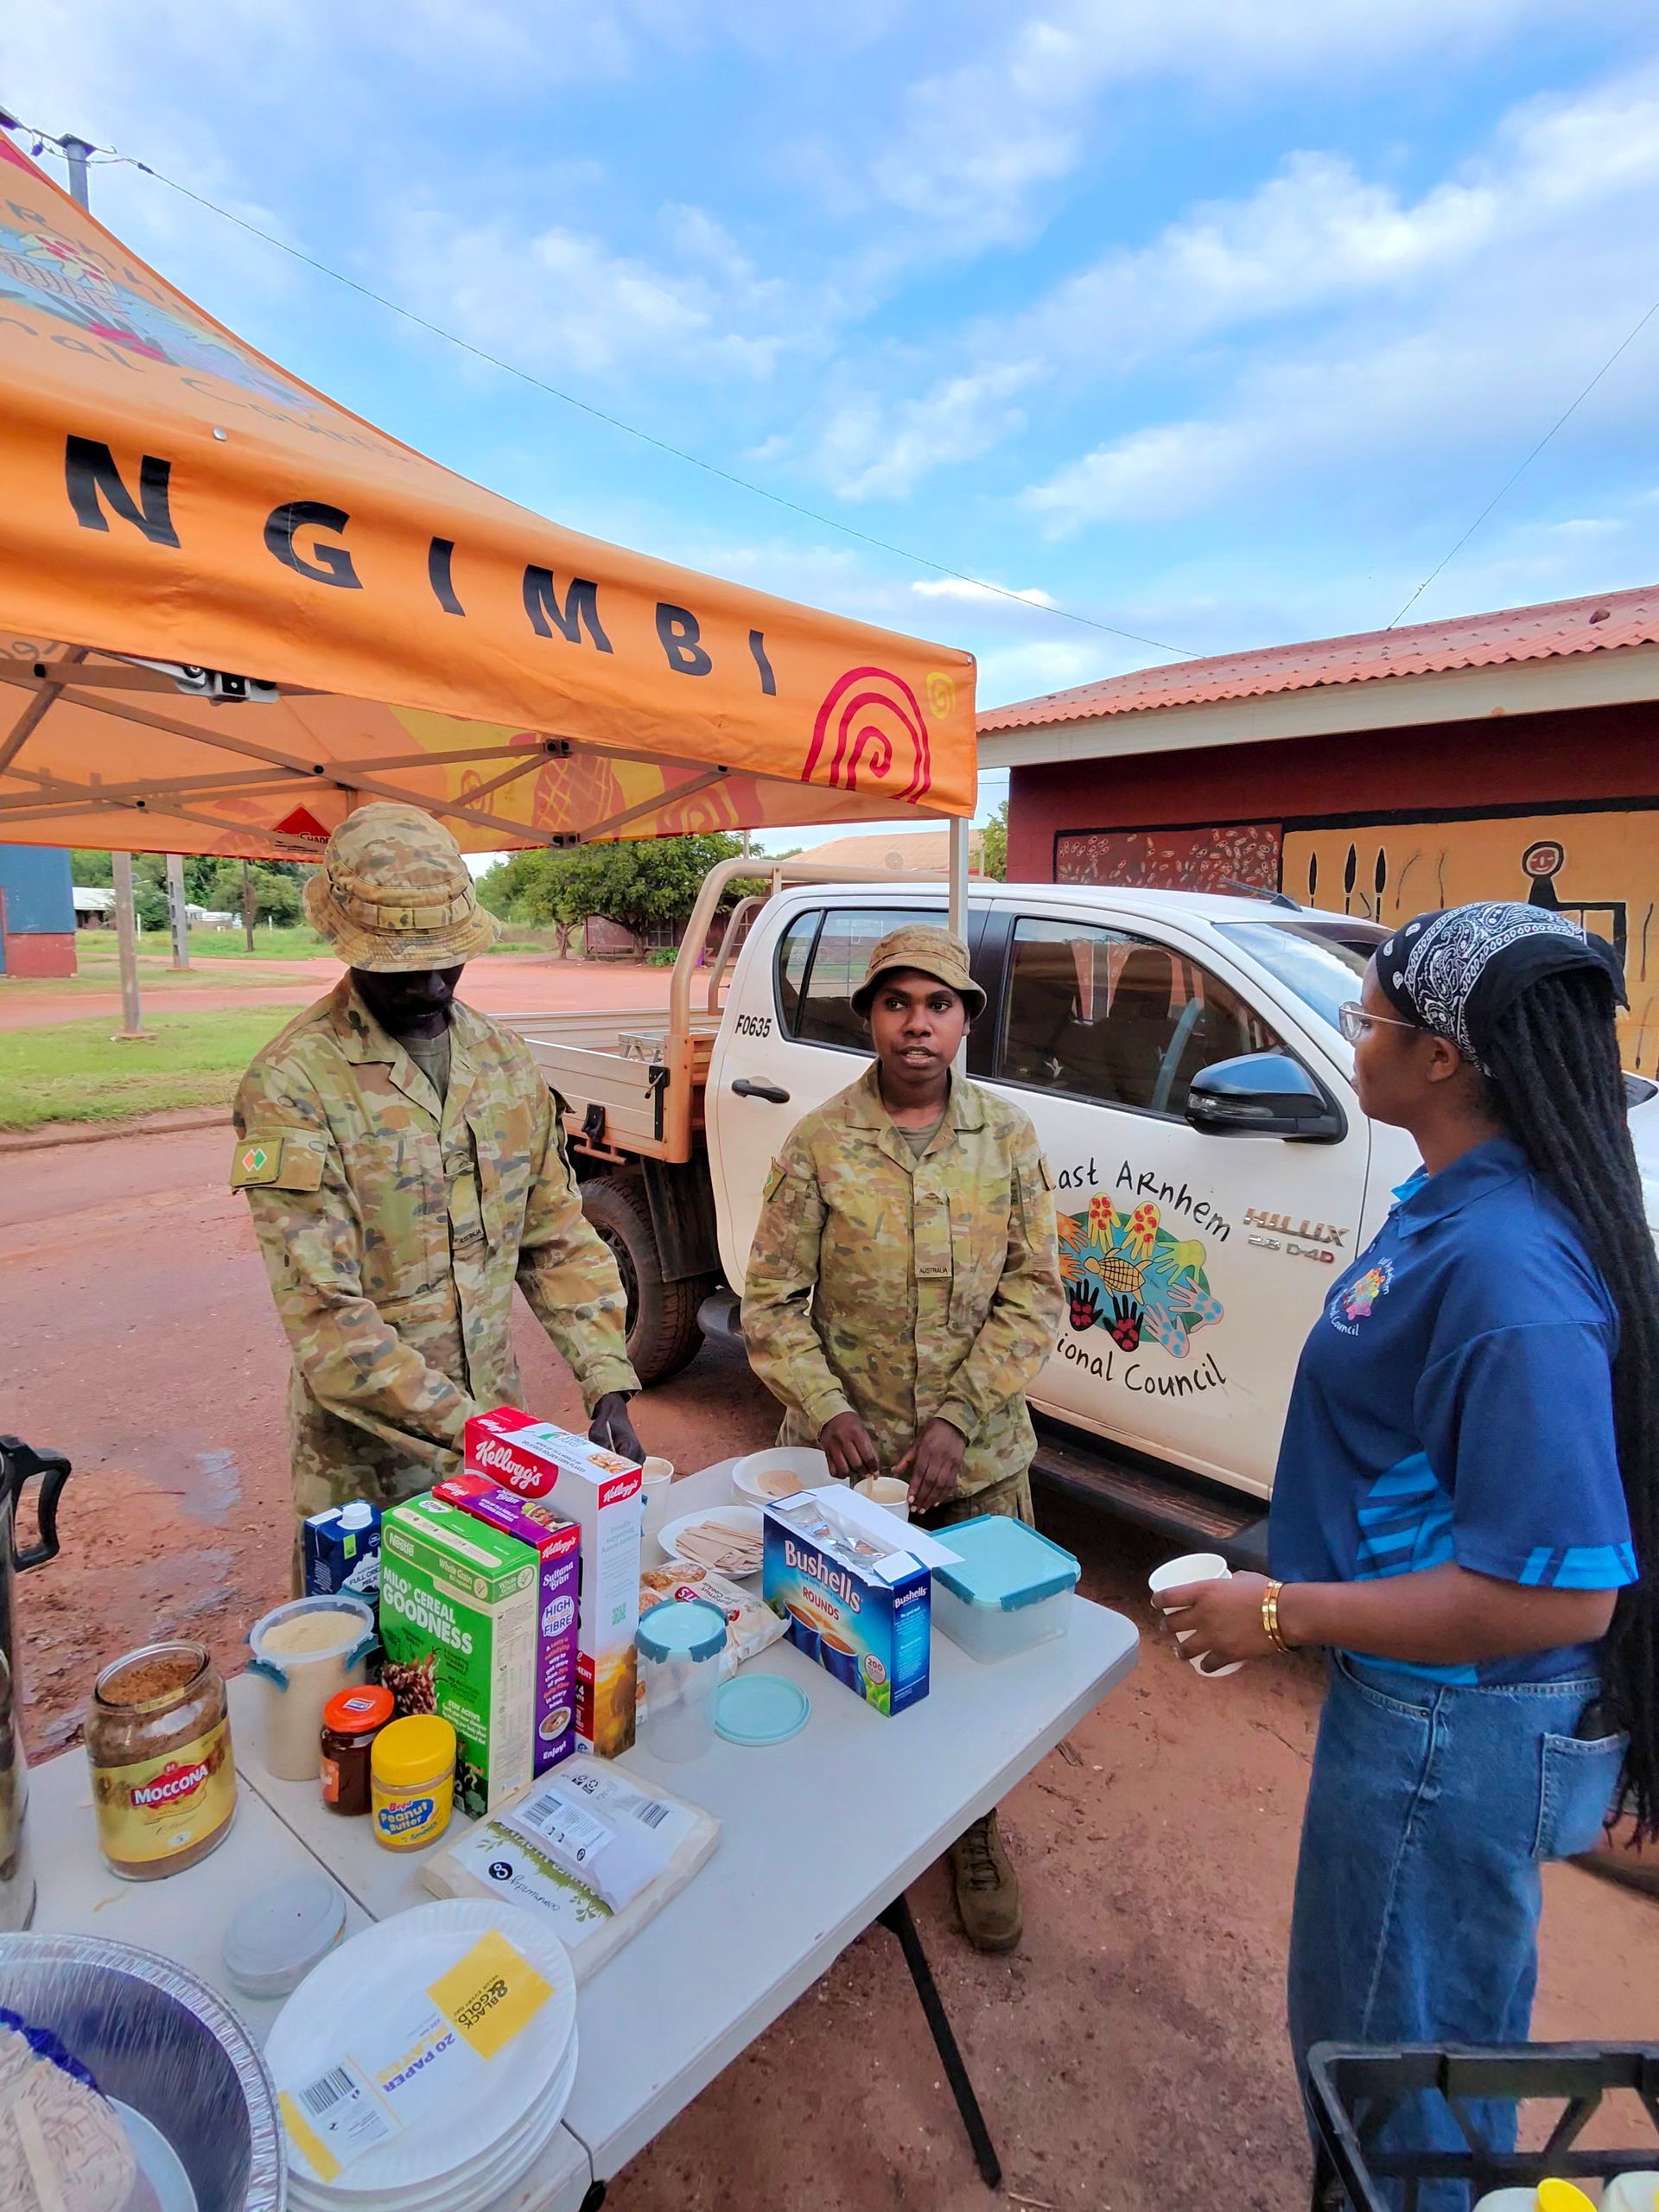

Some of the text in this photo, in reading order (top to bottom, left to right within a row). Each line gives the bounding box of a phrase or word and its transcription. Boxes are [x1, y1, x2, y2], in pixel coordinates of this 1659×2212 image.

[65, 434, 776, 696] NGIMBI
[734, 1014, 772, 1039] F0635
[1050, 1157, 1099, 1190] ast
[1243, 1207, 1351, 1249] HILUX
[1287, 1243, 1335, 1264] D-4D
[1331, 1315, 1359, 1337] Council
[1056, 1332, 1227, 1397] ional Council
[475, 1440, 543, 1490] Kellogg's
[602, 1478, 639, 1503] Kellogg's
[542, 1536, 576, 1559] Kellogg's
[349, 1575, 365, 1586] FULL
[363, 1575, 378, 1587] MILK
[439, 1558, 457, 1575] Whole
[457, 1569, 473, 1585] Grain
[543, 1561, 574, 1587] Sultana
[550, 1573, 569, 1591] Bran
[784, 1540, 861, 1614] Bushells
[413, 1587, 455, 1624] CEREAL
[545, 1598, 571, 1618] HIGH
[801, 1586, 841, 1621] ROUNDS
[894, 1586, 927, 1609] Bushells
[383, 1583, 473, 1655] GOODNESS
[543, 1614, 572, 1636] FIBRE
[868, 1657, 882, 1672] 200
[543, 1740, 567, 1760] Enjoy!
[380, 1802, 428, 1822] Peanut
[388, 1800, 413, 1812] Bega
[390, 1815, 423, 1832] Butter
[510, 1874, 561, 1911] community
[458, 1993, 489, 2024] GOLD
[463, 1996, 499, 2030] BLACK
[383, 2032, 455, 2092] 20 PAPER
